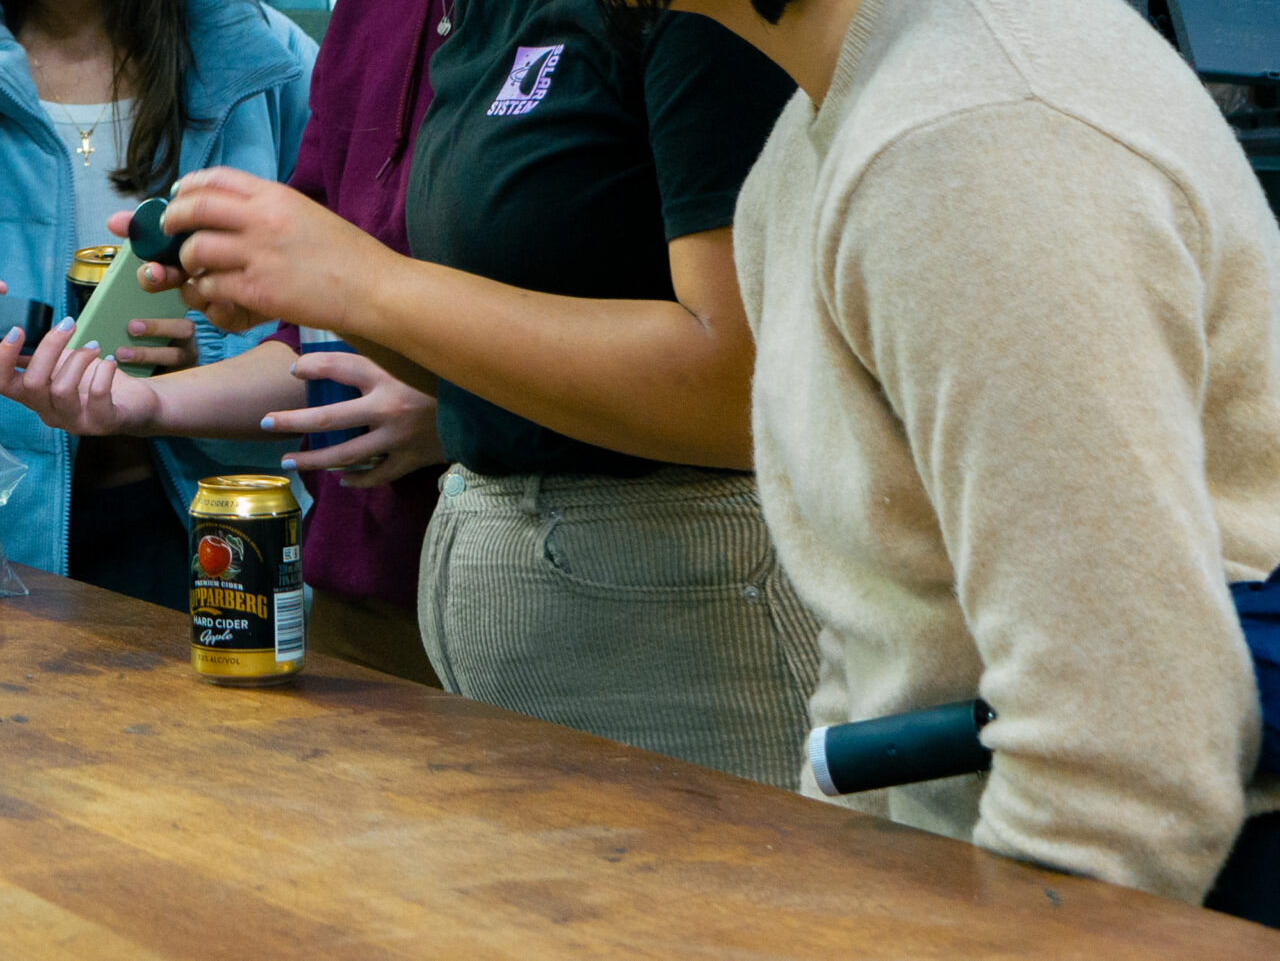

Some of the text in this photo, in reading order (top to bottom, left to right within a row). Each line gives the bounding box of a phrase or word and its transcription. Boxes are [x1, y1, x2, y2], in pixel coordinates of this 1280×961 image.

[530, 44, 565, 101] SOLAR
[221, 581, 244, 591] CIDER
[193, 616, 249, 630] HARD CIDER
[200, 629, 234, 646] Apple
